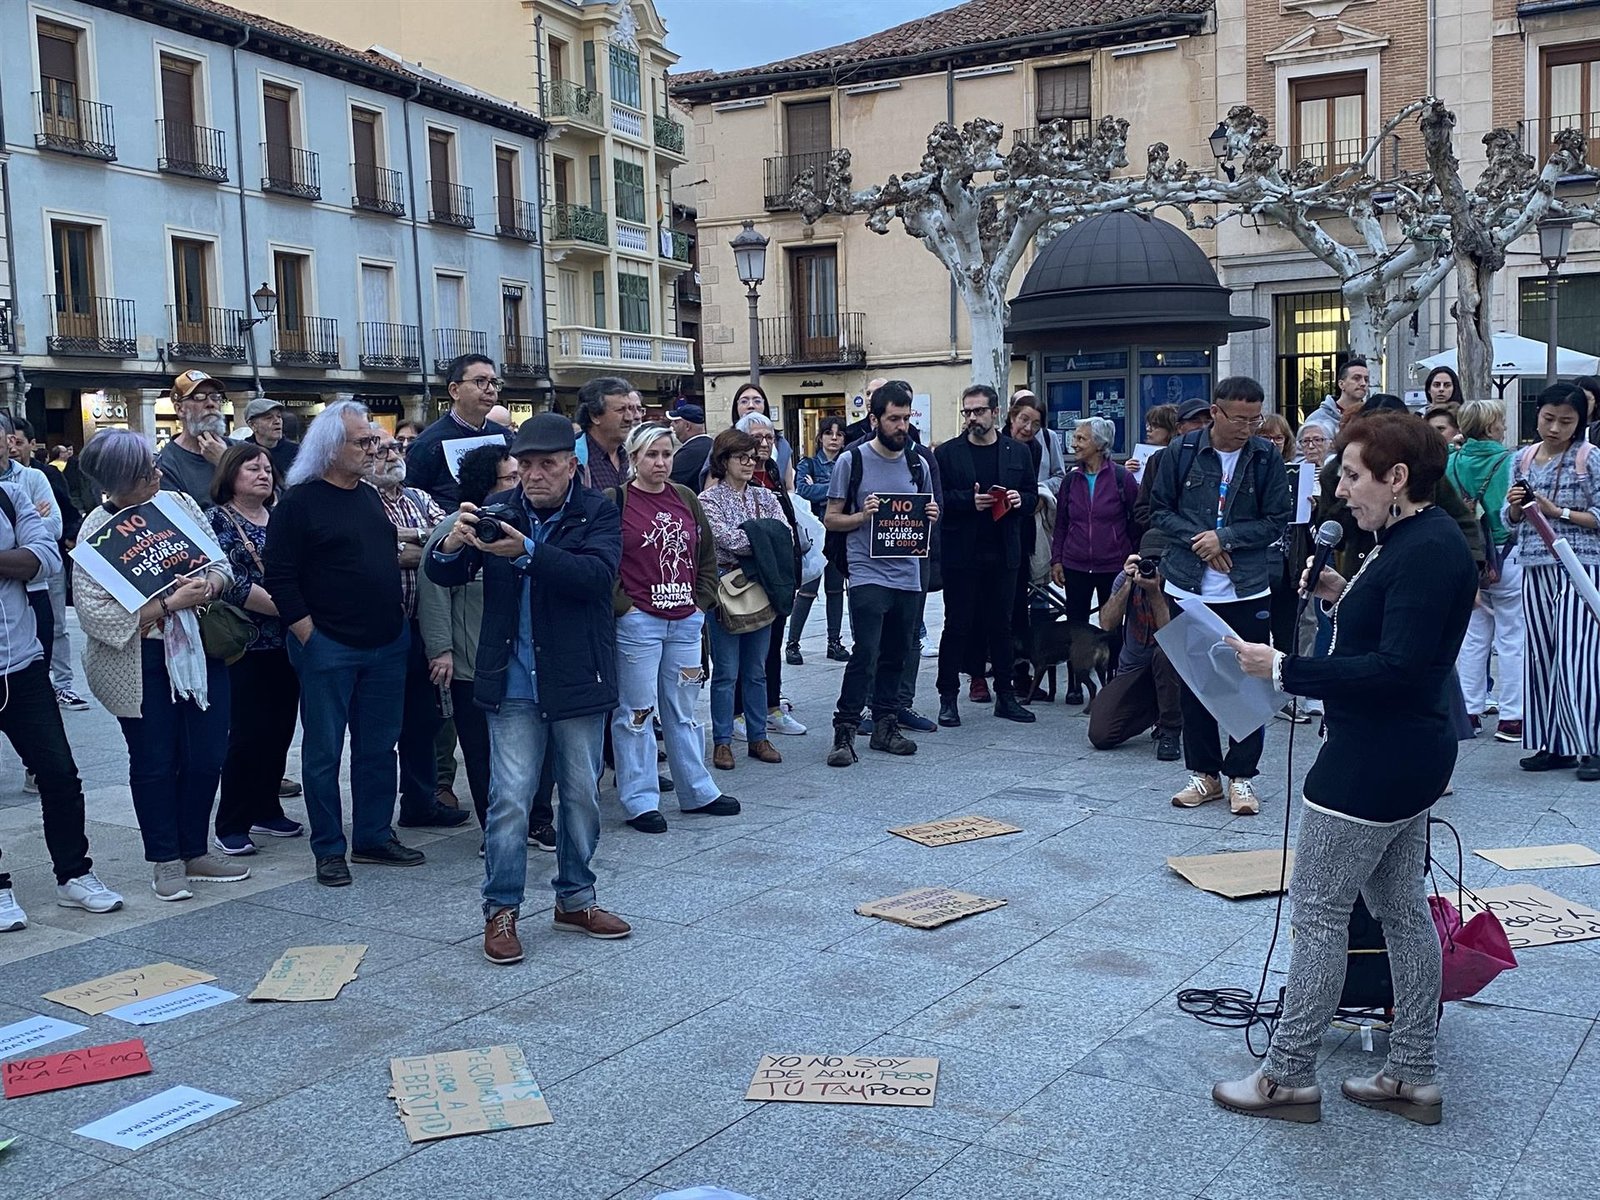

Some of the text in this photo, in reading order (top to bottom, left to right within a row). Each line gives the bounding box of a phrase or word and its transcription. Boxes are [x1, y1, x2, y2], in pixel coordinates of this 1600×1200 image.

[892, 501, 912, 512] NO
[116, 515, 146, 537] NO
[135, 529, 154, 542] A LA
[877, 532, 924, 540] DISCURSOS
[120, 529, 176, 564] XENOFOBIA
[149, 547, 157, 555] A
[157, 540, 171, 550] LOS
[132, 540, 189, 577] DISCURSOS
[150, 551, 189, 576] DE ODIO
[1486, 897, 1552, 911] NO
[1499, 909, 1595, 927] Y POR
[163, 974, 202, 988] NO
[95, 988, 139, 1003] AL
[133, 994, 196, 1016] FRONTERAS
[149, 998, 206, 1018] BANDERAS
[0, 1024, 53, 1044] ONTERAS
[8, 1050, 105, 1074] NO AL
[8, 1052, 144, 1085] RACISMO
[767, 1055, 910, 1069] YO NO SOY
[760, 1069, 805, 1078] DE
[878, 1070, 934, 1082] PERO
[401, 1058, 452, 1134] LIBERTAD
[752, 1080, 931, 1100] TÚ TAMPOCO
[116, 1103, 186, 1136] FRONTERAS
[136, 1102, 215, 1138] NI BANDERAS
